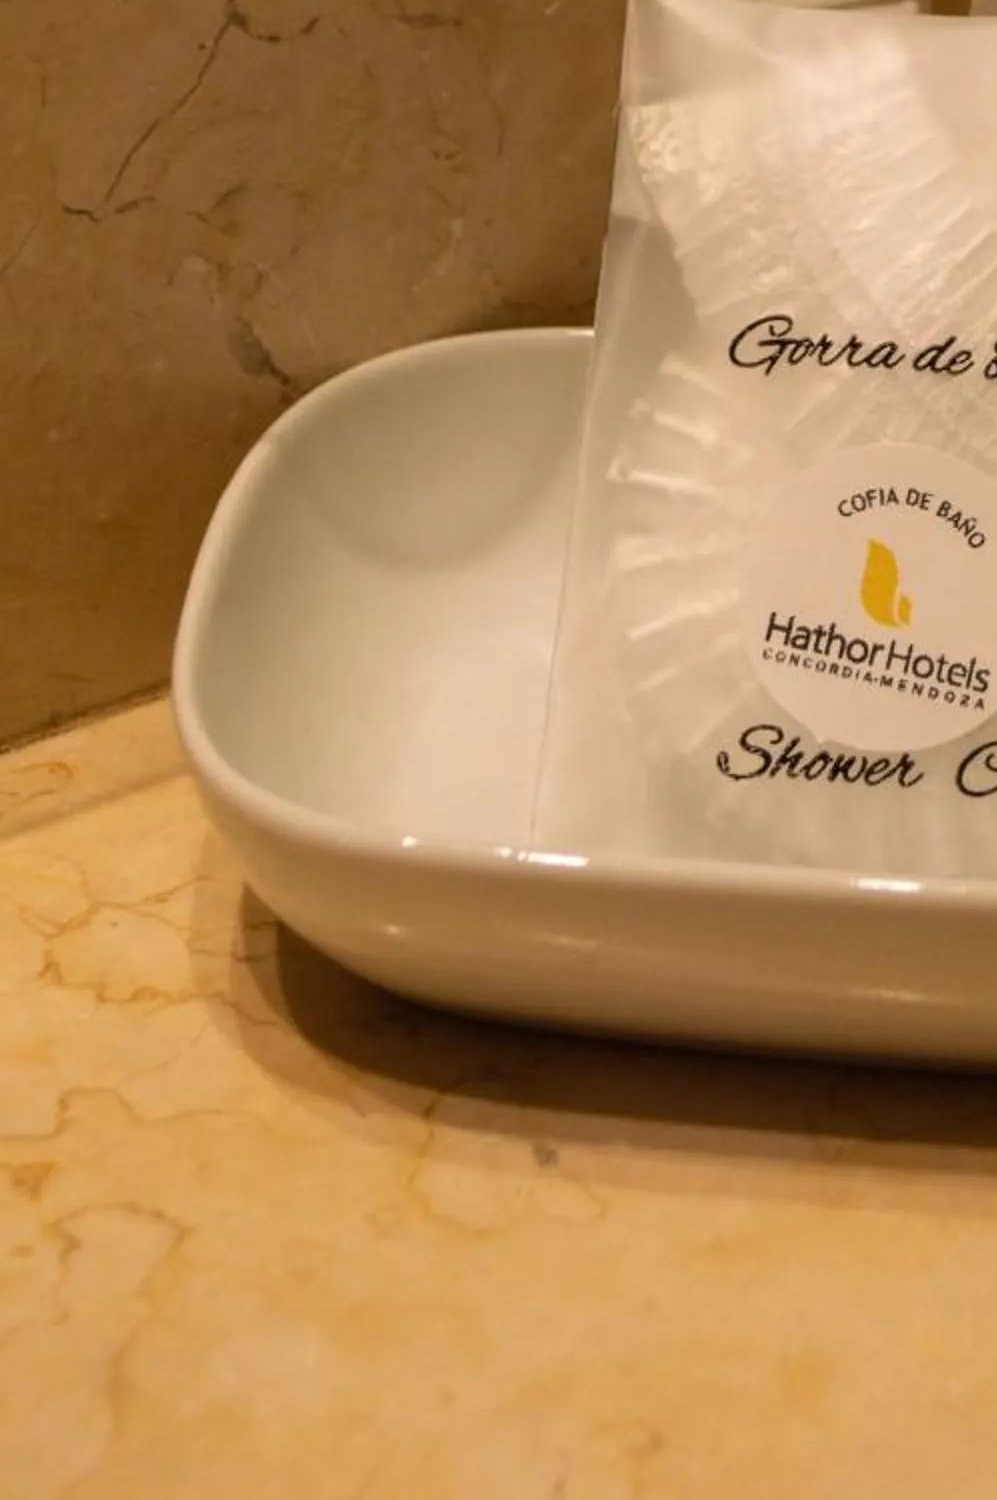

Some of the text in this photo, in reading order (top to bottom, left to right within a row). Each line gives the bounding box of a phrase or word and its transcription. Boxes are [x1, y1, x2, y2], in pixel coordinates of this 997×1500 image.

[728, 313, 906, 377] Gorra
[911, 335, 976, 376] de
[837, 487, 987, 550] COFIA DE BAÑO
[715, 723, 925, 789] Shower
